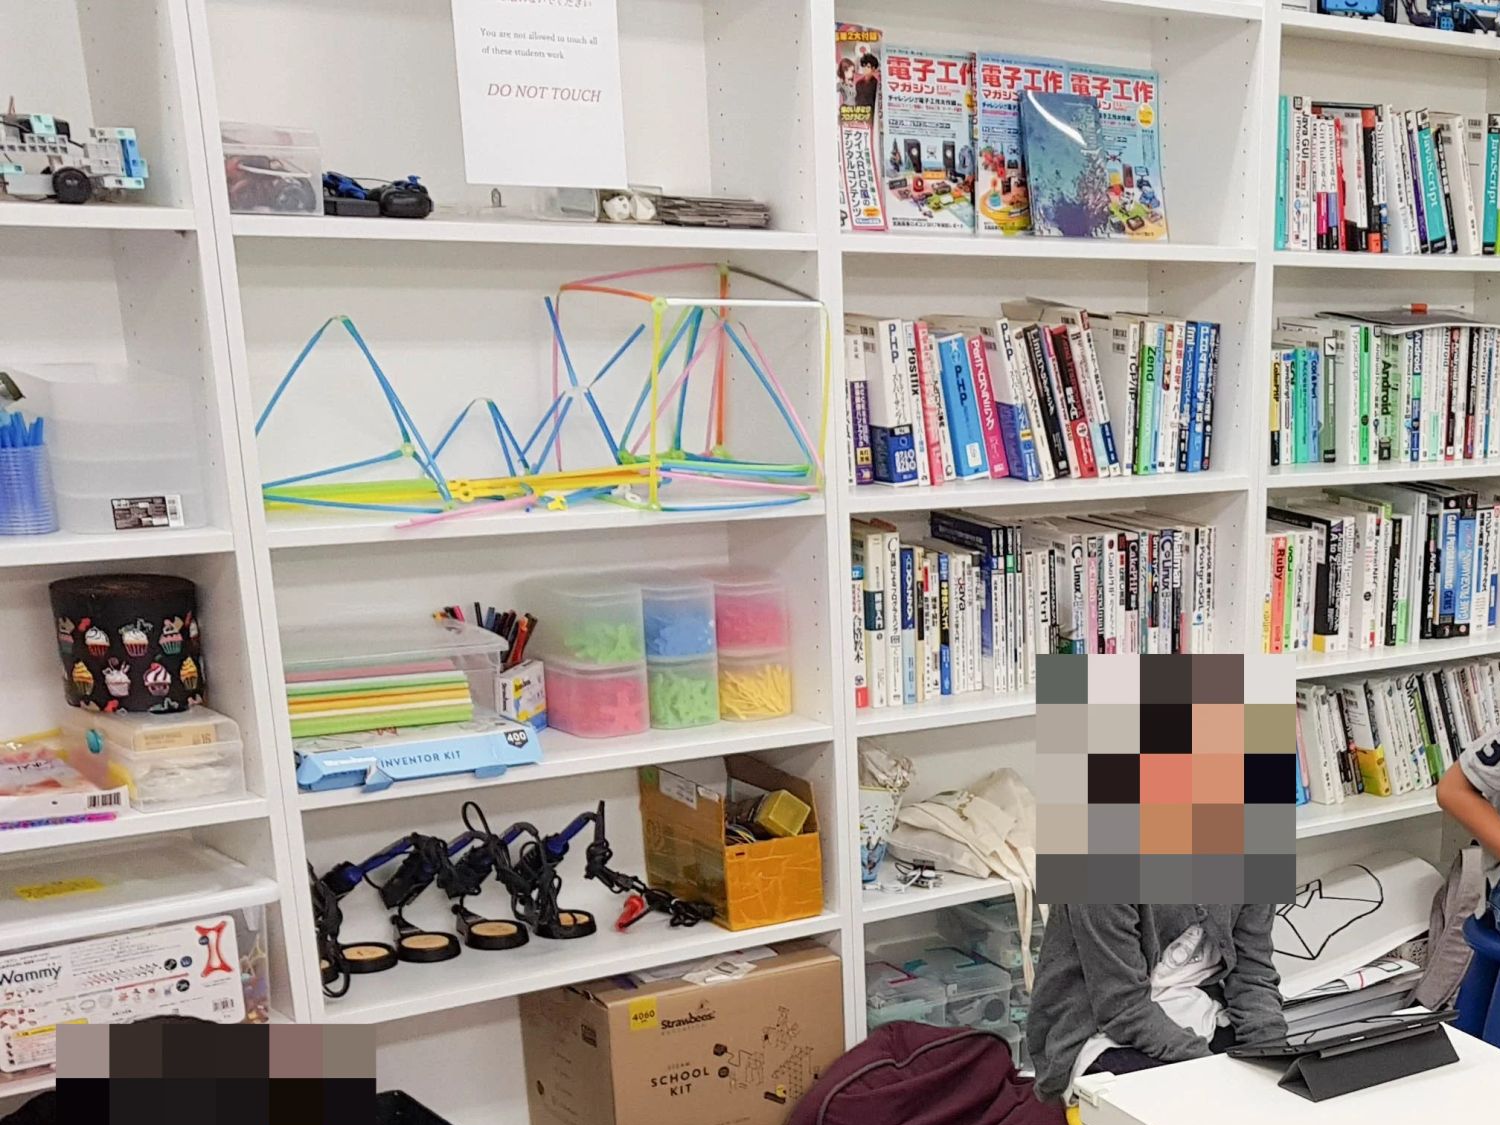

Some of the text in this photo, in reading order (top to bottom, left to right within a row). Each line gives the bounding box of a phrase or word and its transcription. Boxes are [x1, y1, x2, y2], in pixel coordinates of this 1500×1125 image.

[480, 28, 598, 45] You are not allowed to touch all
[482, 46, 564, 60] of these students work
[487, 83, 602, 103] DO NOT TOUCH
[888, 81, 935, 95] マガジン
[981, 64, 1062, 94] 電子工作
[1070, 72, 1154, 103] 電子工作
[844, 129, 862, 217] デジタルコンテンツ
[1422, 133, 1438, 208] JavaScript
[1489, 134, 1499, 204] JavaScript
[888, 323, 899, 364] PHP
[1001, 322, 1014, 361] PHP
[1414, 331, 1422, 373] Android
[907, 347, 920, 396] Postfix
[1128, 355, 1139, 401] TCP/IP
[1146, 346, 1157, 382] Zend
[954, 365, 968, 407] PHP
[1381, 359, 1392, 416] Android
[1129, 541, 1138, 595] CakePHP
[1172, 531, 1182, 588] Mailman
[1275, 548, 1286, 580] Ruby
[957, 577, 966, 612] Java
[1195, 546, 1206, 609] PostgreSQL
[506, 731, 527, 742] 400
[380, 752, 440, 769] INVENTOR
[444, 750, 462, 761] KIT
[632, 1009, 656, 1022] 4060
[661, 1011, 716, 1030] Strawbees
[650, 1066, 710, 1088] SCHOOL
[670, 1083, 692, 1097] KIT
